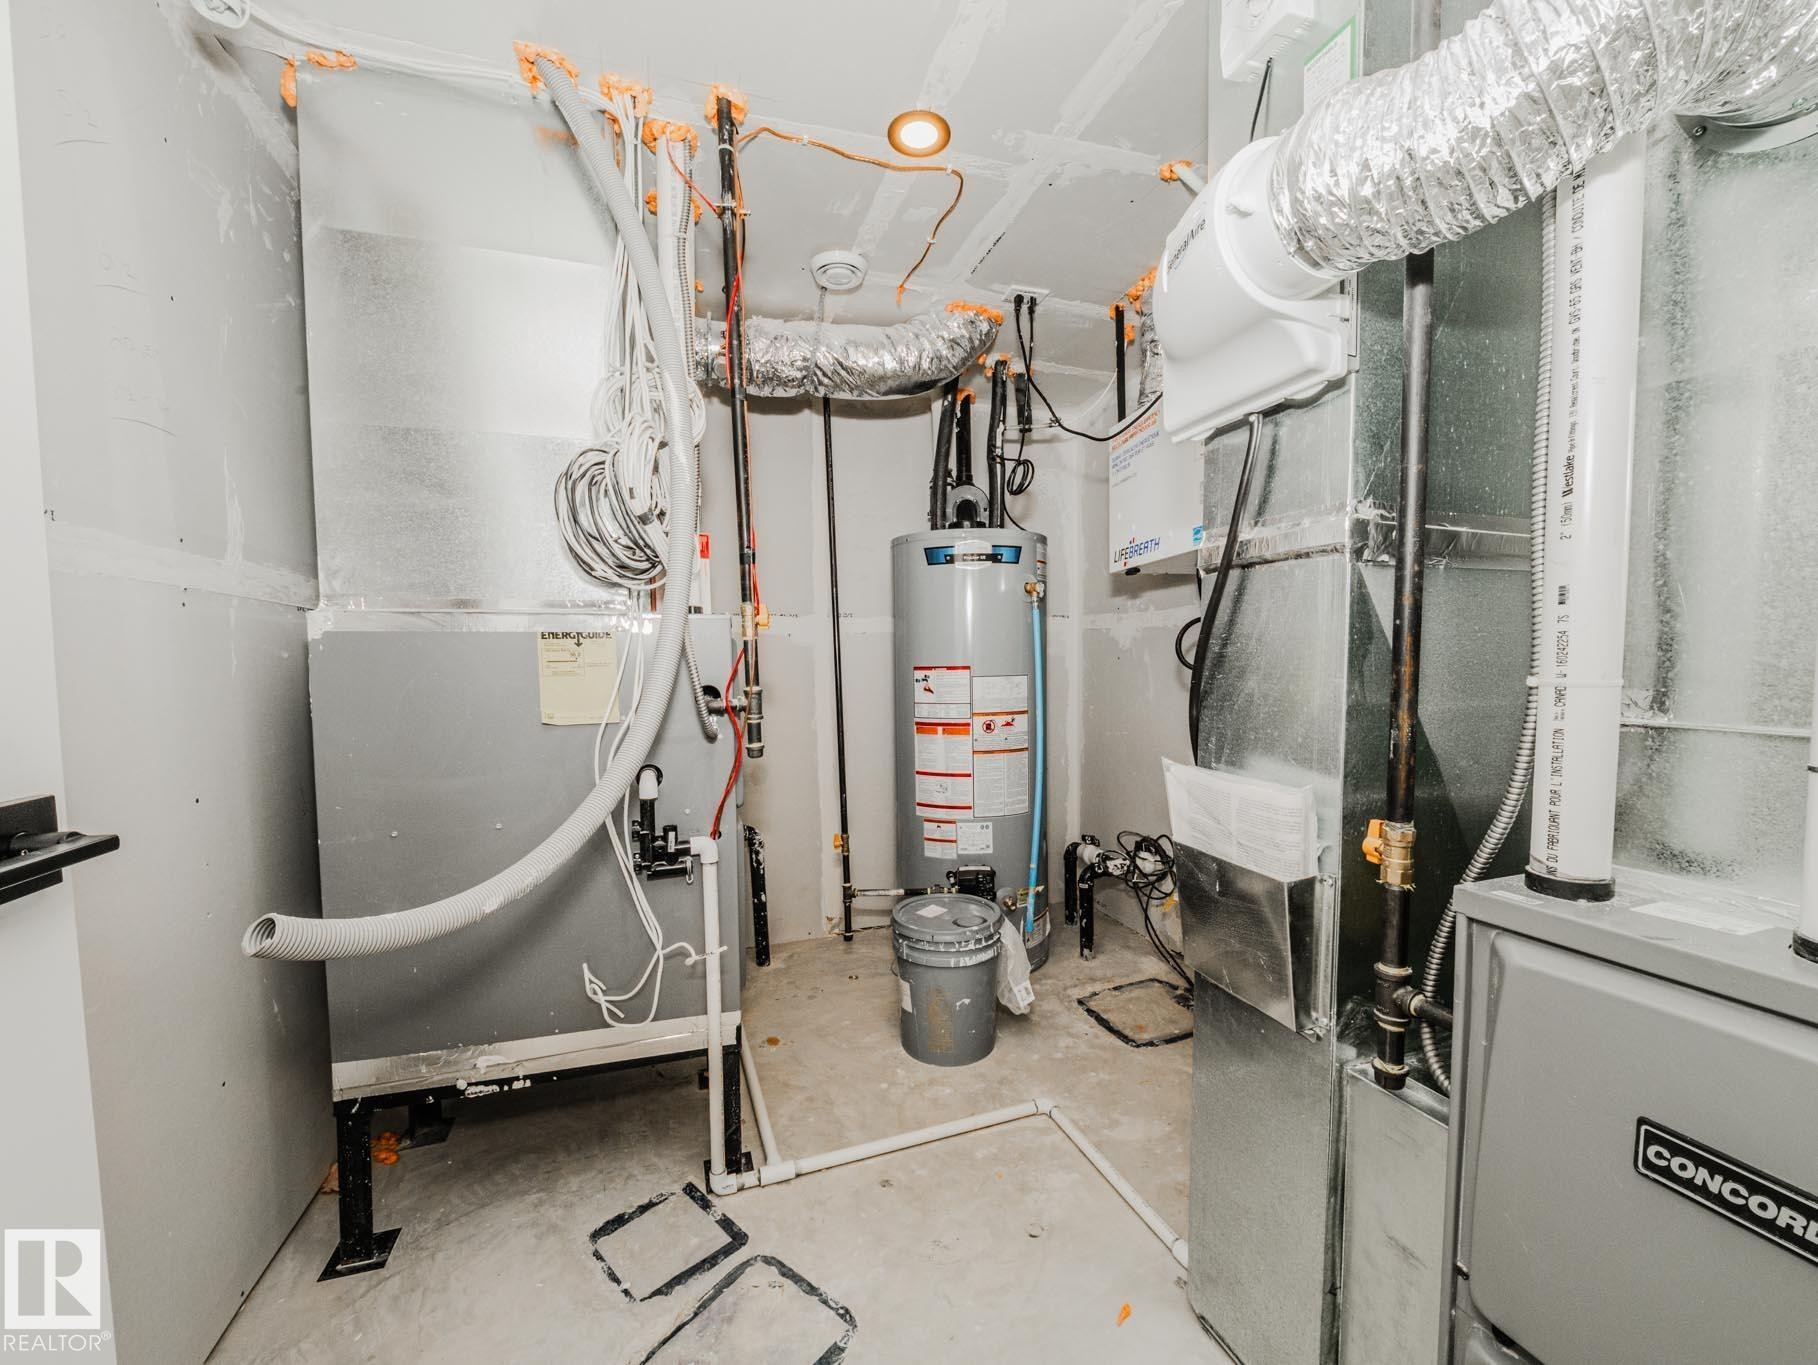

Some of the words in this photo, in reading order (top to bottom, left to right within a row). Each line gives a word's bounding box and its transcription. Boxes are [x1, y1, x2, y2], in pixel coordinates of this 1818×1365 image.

[1560, 454, 1574, 498] Westlake
[1114, 537, 1160, 563] LIFEBREATH
[1549, 790, 1562, 806] POUR
[1546, 853, 1558, 863] DU
